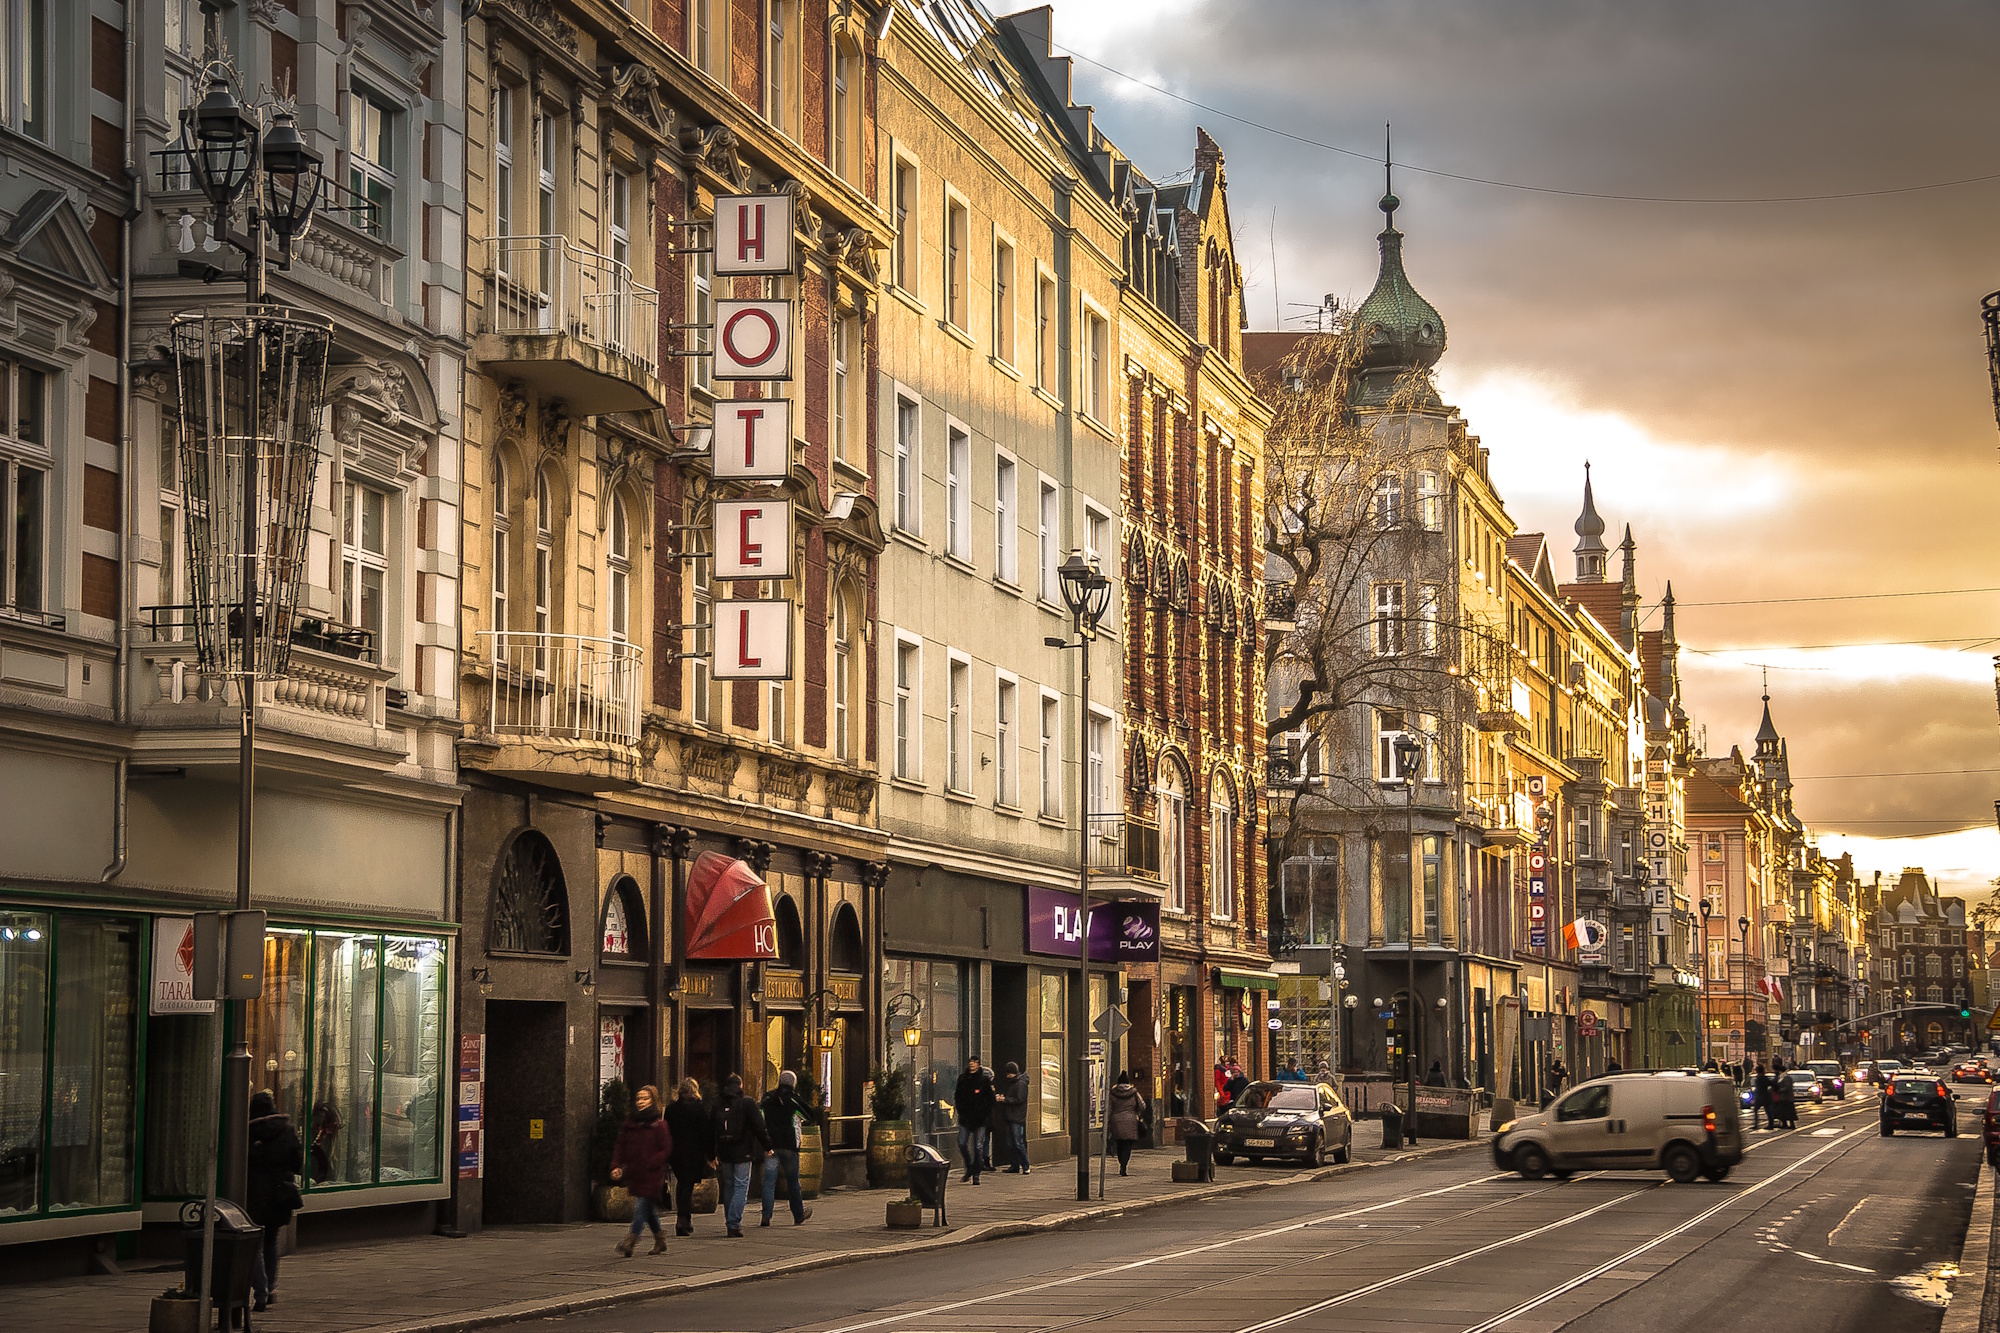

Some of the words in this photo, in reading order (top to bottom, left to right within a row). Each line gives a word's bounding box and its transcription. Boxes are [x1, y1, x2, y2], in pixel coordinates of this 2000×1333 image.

[722, 203, 781, 669] HOTEL
[1529, 779, 1545, 919] OORD
[1651, 805, 1666, 932] HOTEL
[1120, 941, 1154, 949] PLAY
